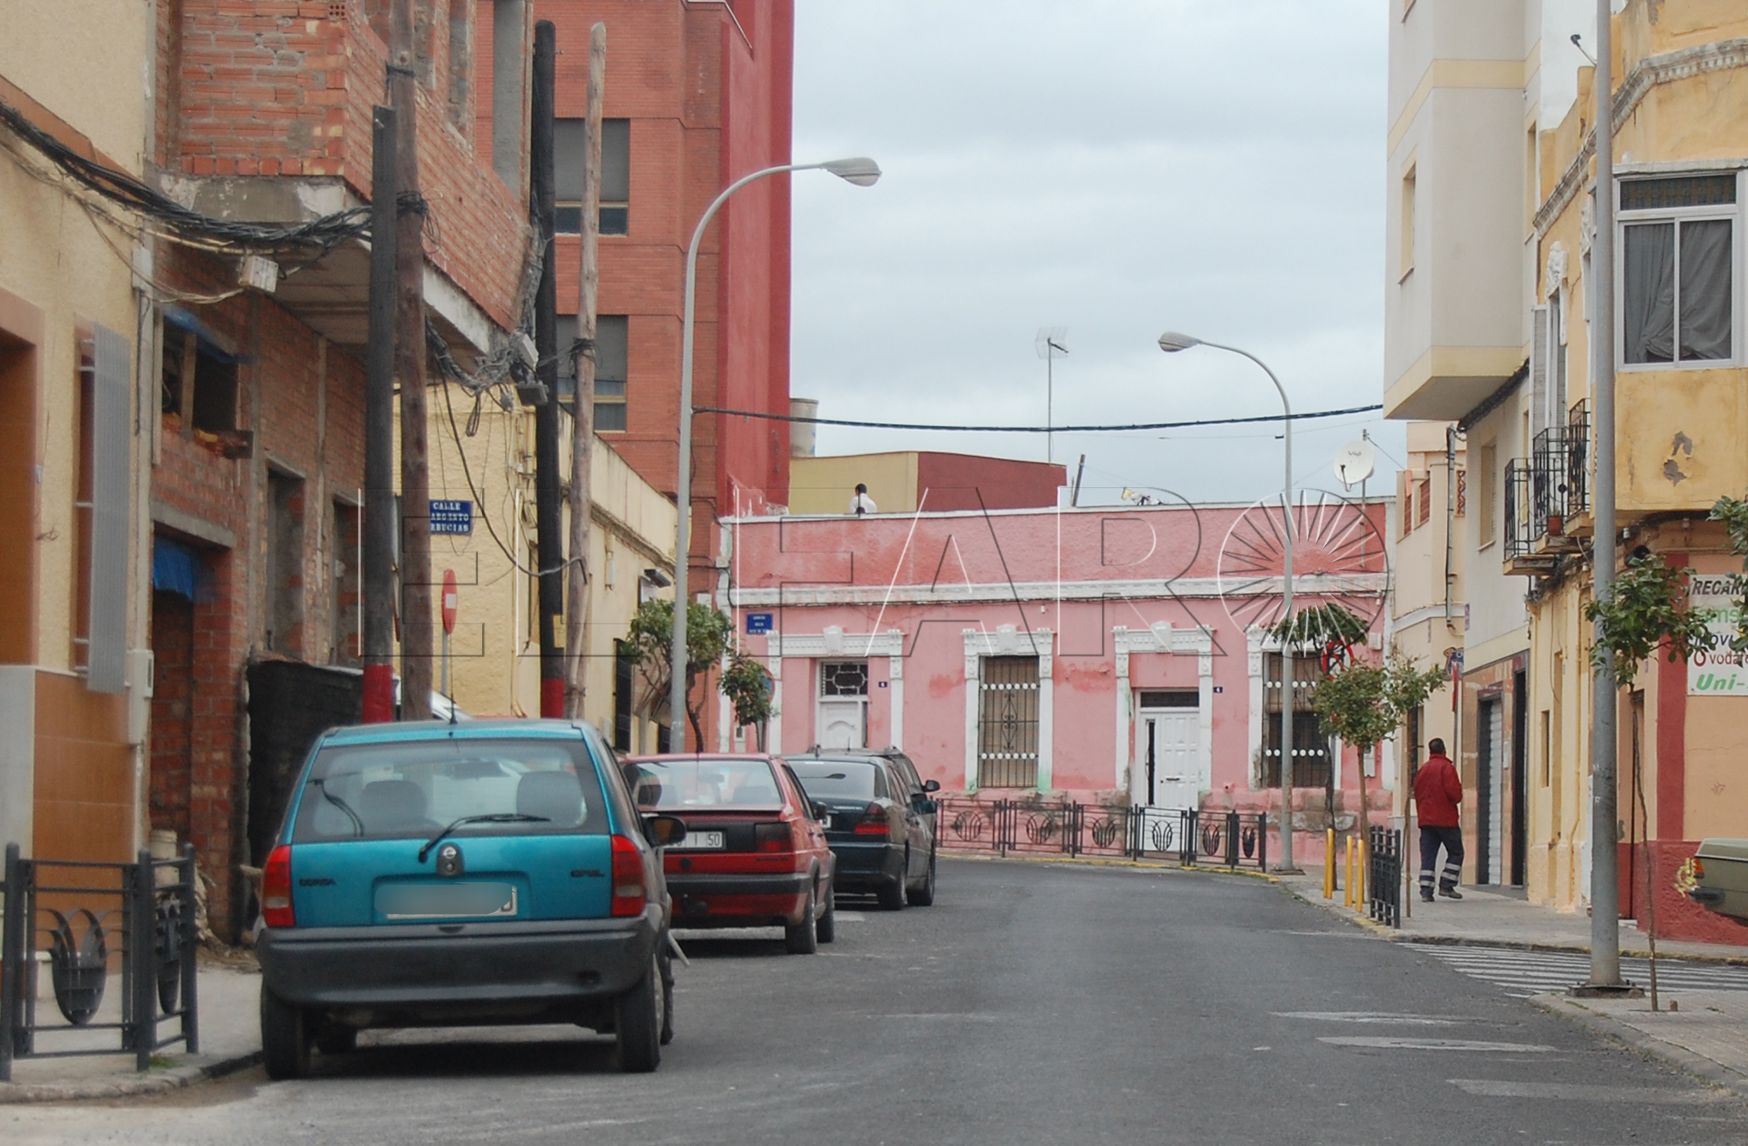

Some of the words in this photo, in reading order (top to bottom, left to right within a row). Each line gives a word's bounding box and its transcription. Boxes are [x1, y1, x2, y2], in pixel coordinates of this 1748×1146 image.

[432, 502, 461, 511] CALLE
[431, 512, 469, 522] ARGENTO
[431, 523, 469, 532] RBUCIAS
[707, 833, 721, 847] 50
